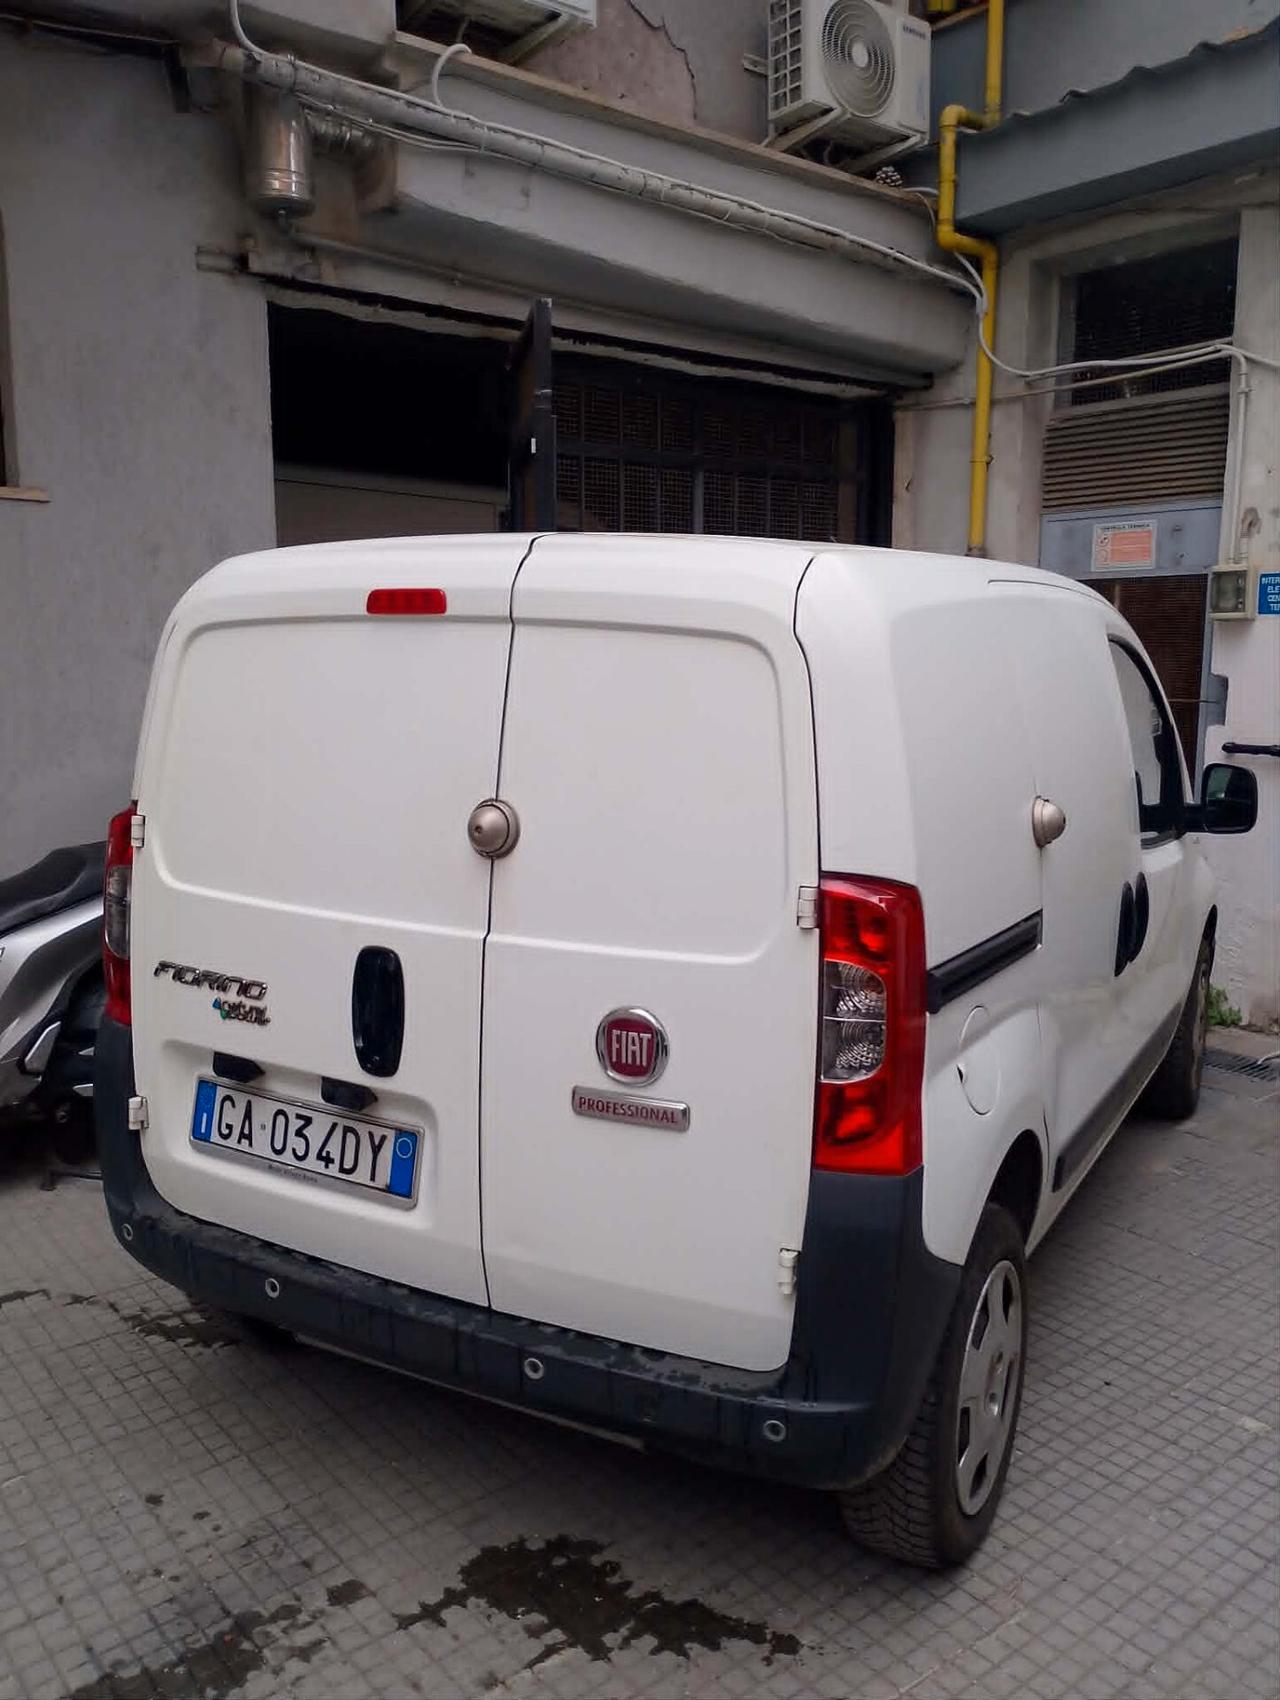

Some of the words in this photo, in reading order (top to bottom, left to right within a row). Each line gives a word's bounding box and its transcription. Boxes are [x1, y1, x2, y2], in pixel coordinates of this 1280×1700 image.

[153, 960, 268, 1001] FIORINO
[611, 1029, 652, 1067] FIAT
[578, 1096, 678, 1124] PROFESSIONAL
